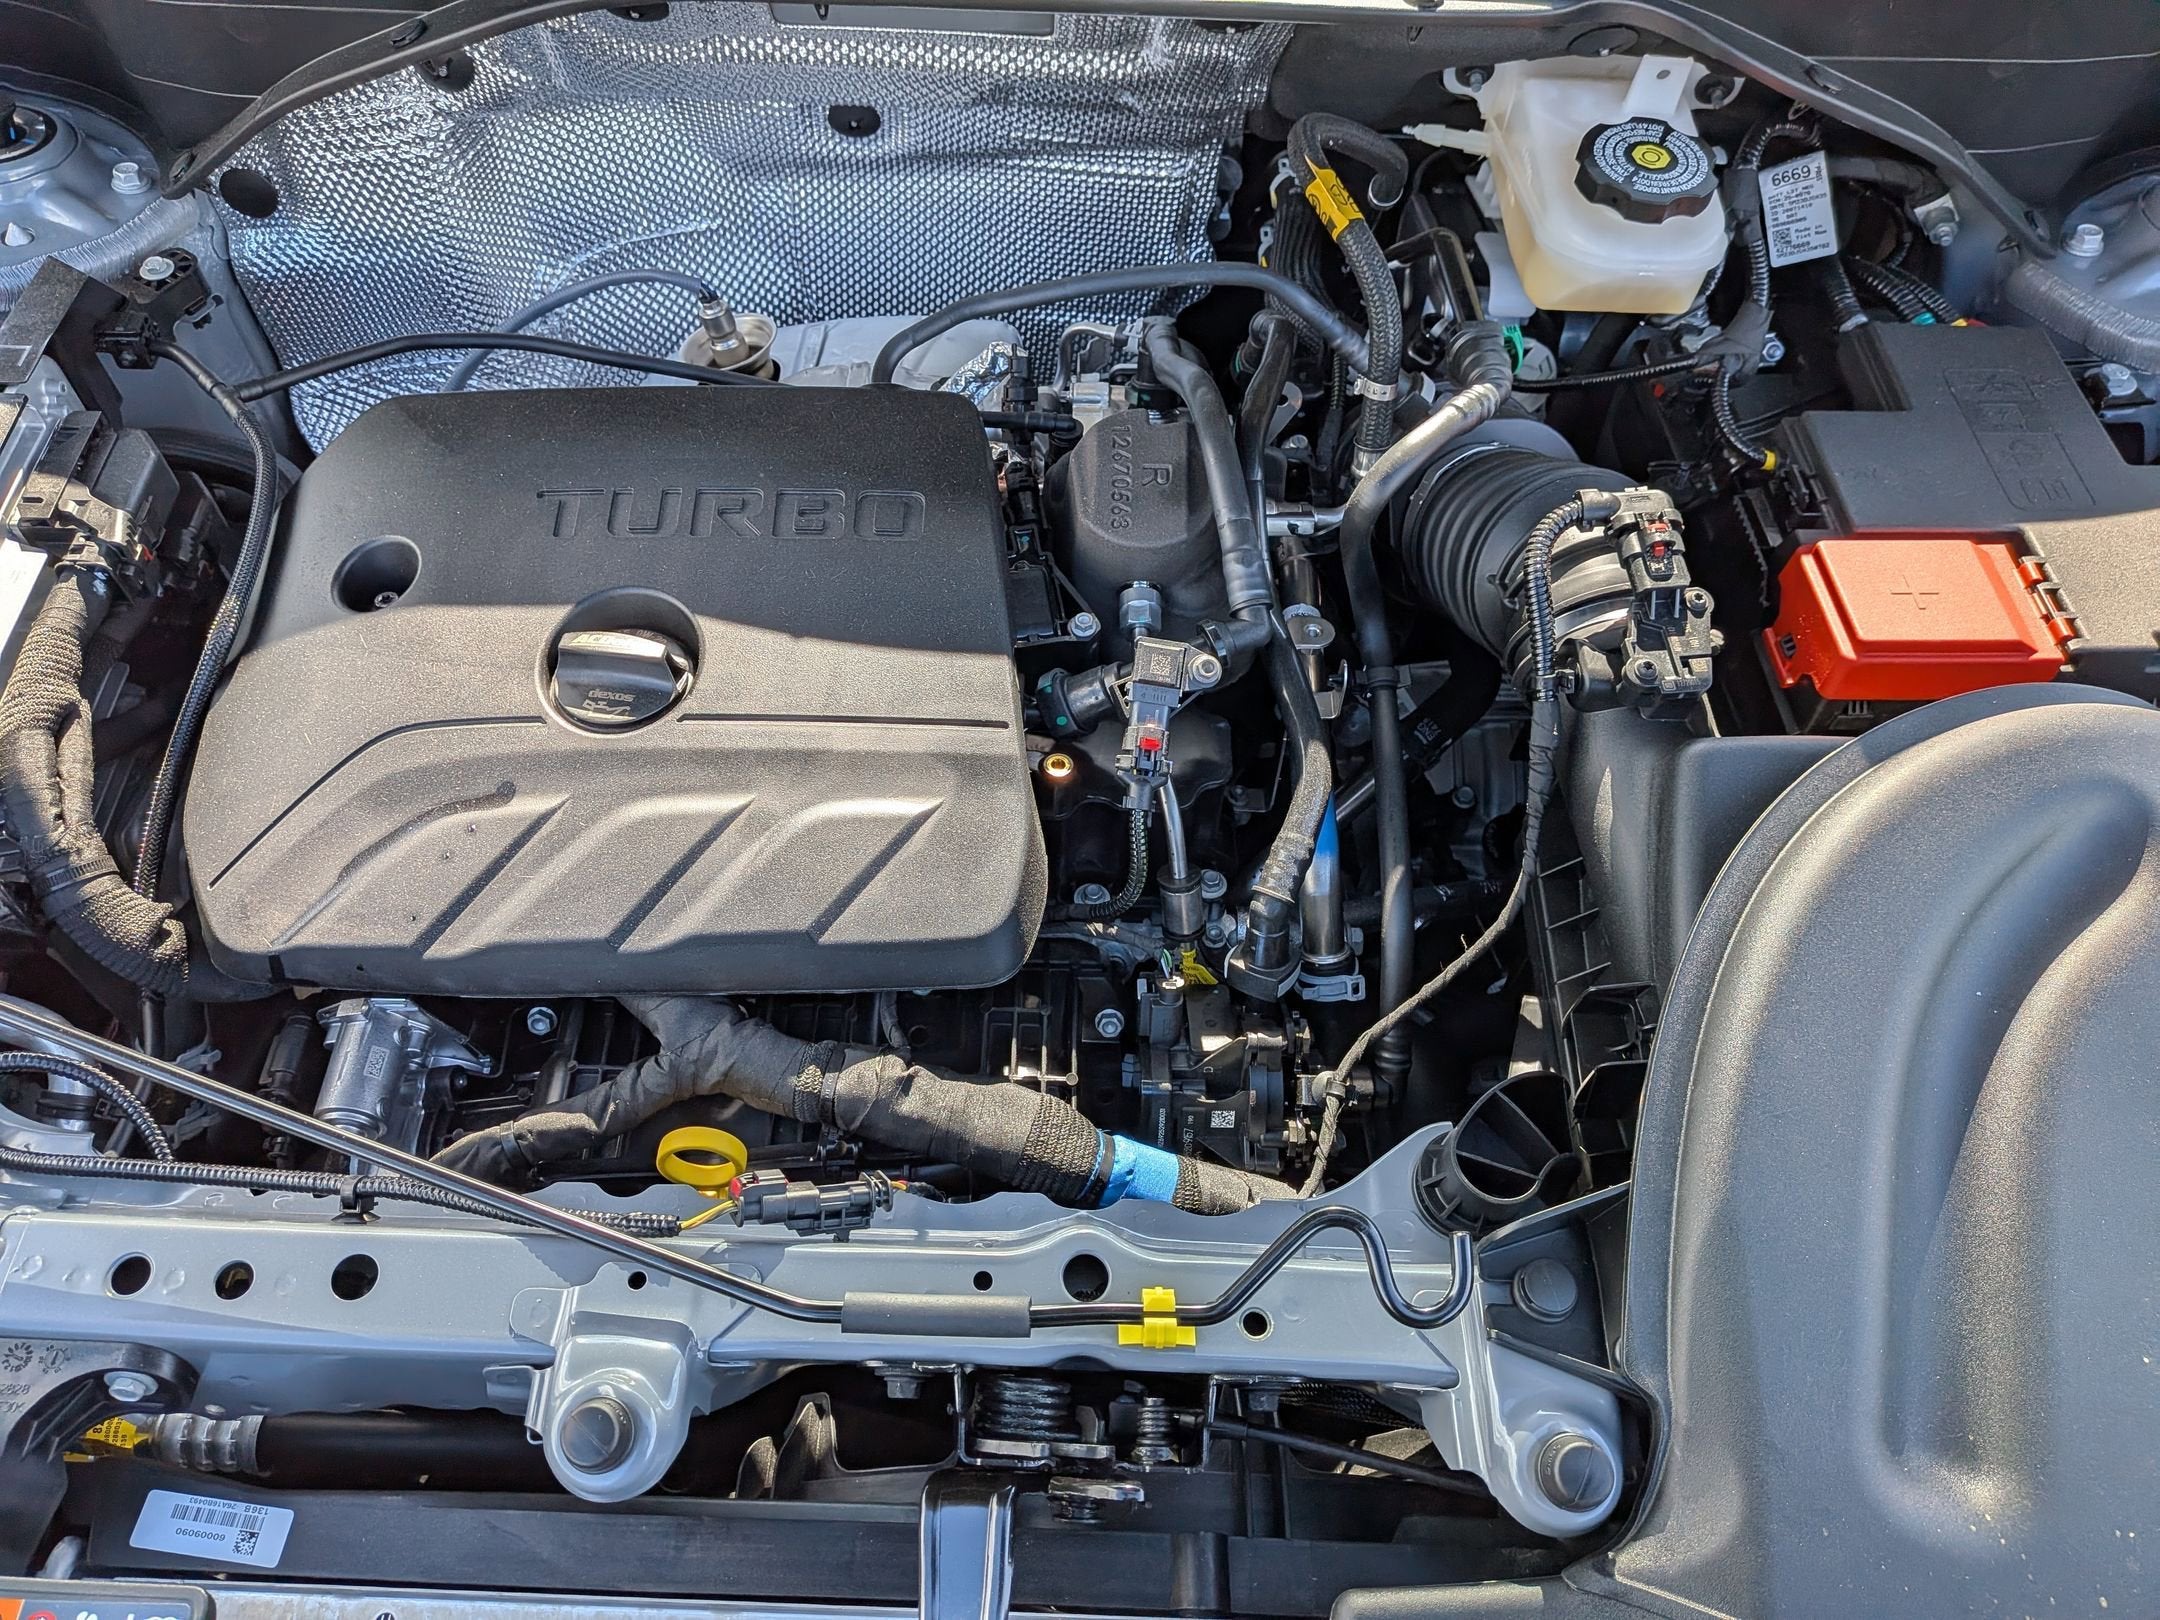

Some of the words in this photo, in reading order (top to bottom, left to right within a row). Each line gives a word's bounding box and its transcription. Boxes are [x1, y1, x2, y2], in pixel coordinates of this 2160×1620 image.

[1771, 164, 1811, 187] 6669
[1142, 464, 1172, 486] R
[536, 487, 926, 541] TURBO
[588, 688, 637, 702] dexos
[244, 1505, 269, 1516] 136B
[175, 1527, 226, 1542] 60009090
